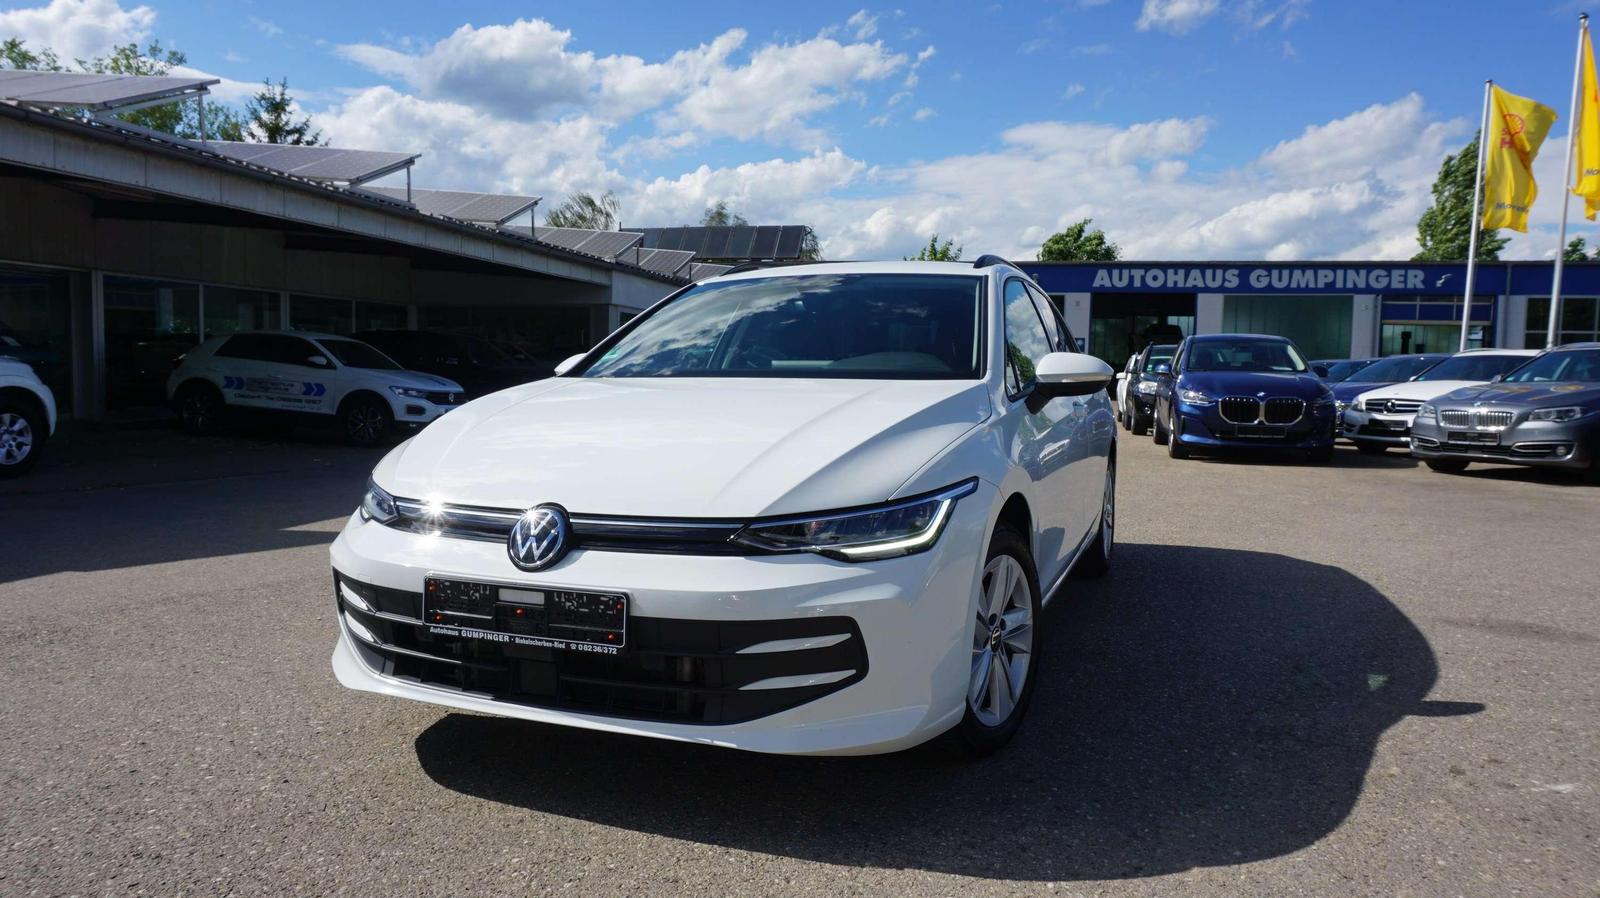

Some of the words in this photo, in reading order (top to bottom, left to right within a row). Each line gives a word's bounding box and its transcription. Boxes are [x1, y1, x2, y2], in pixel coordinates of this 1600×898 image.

[1093, 268, 1240, 289] AUTOHAUS
[1249, 268, 1425, 290] GUMPINGER
[429, 626, 459, 637] Autohaus
[461, 630, 510, 643] GUMPINGER
